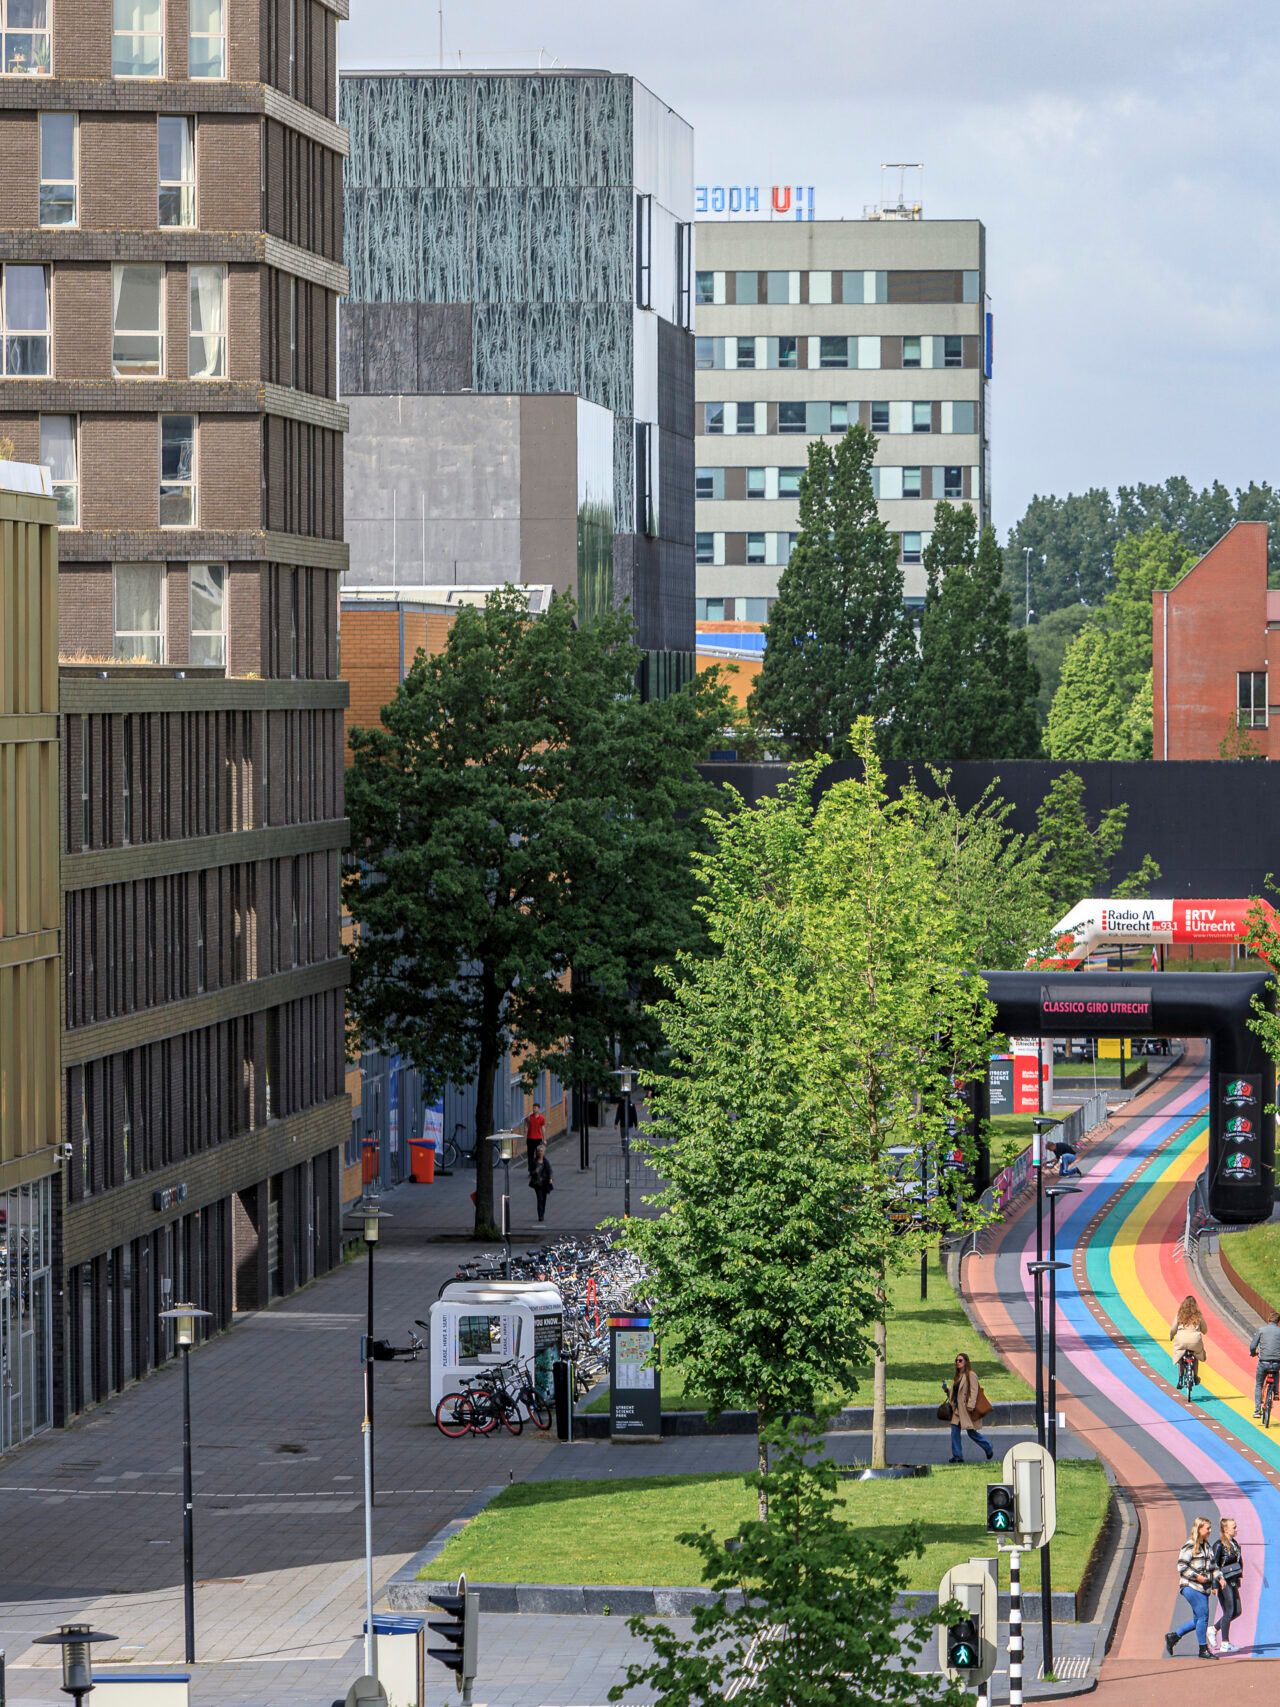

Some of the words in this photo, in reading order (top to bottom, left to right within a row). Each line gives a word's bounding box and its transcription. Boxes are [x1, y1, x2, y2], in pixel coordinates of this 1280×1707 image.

[1108, 910, 1139, 920] Radio
[1142, 910, 1154, 920] M
[1192, 909, 1216, 921] RTV
[1108, 921, 1150, 931] Utrecht
[1192, 920, 1236, 932] Utrecht
[1043, 1001, 1085, 1013] CLASSICO
[1086, 1002, 1109, 1013] GIRO
[1110, 1002, 1149, 1014] UTRECHT
